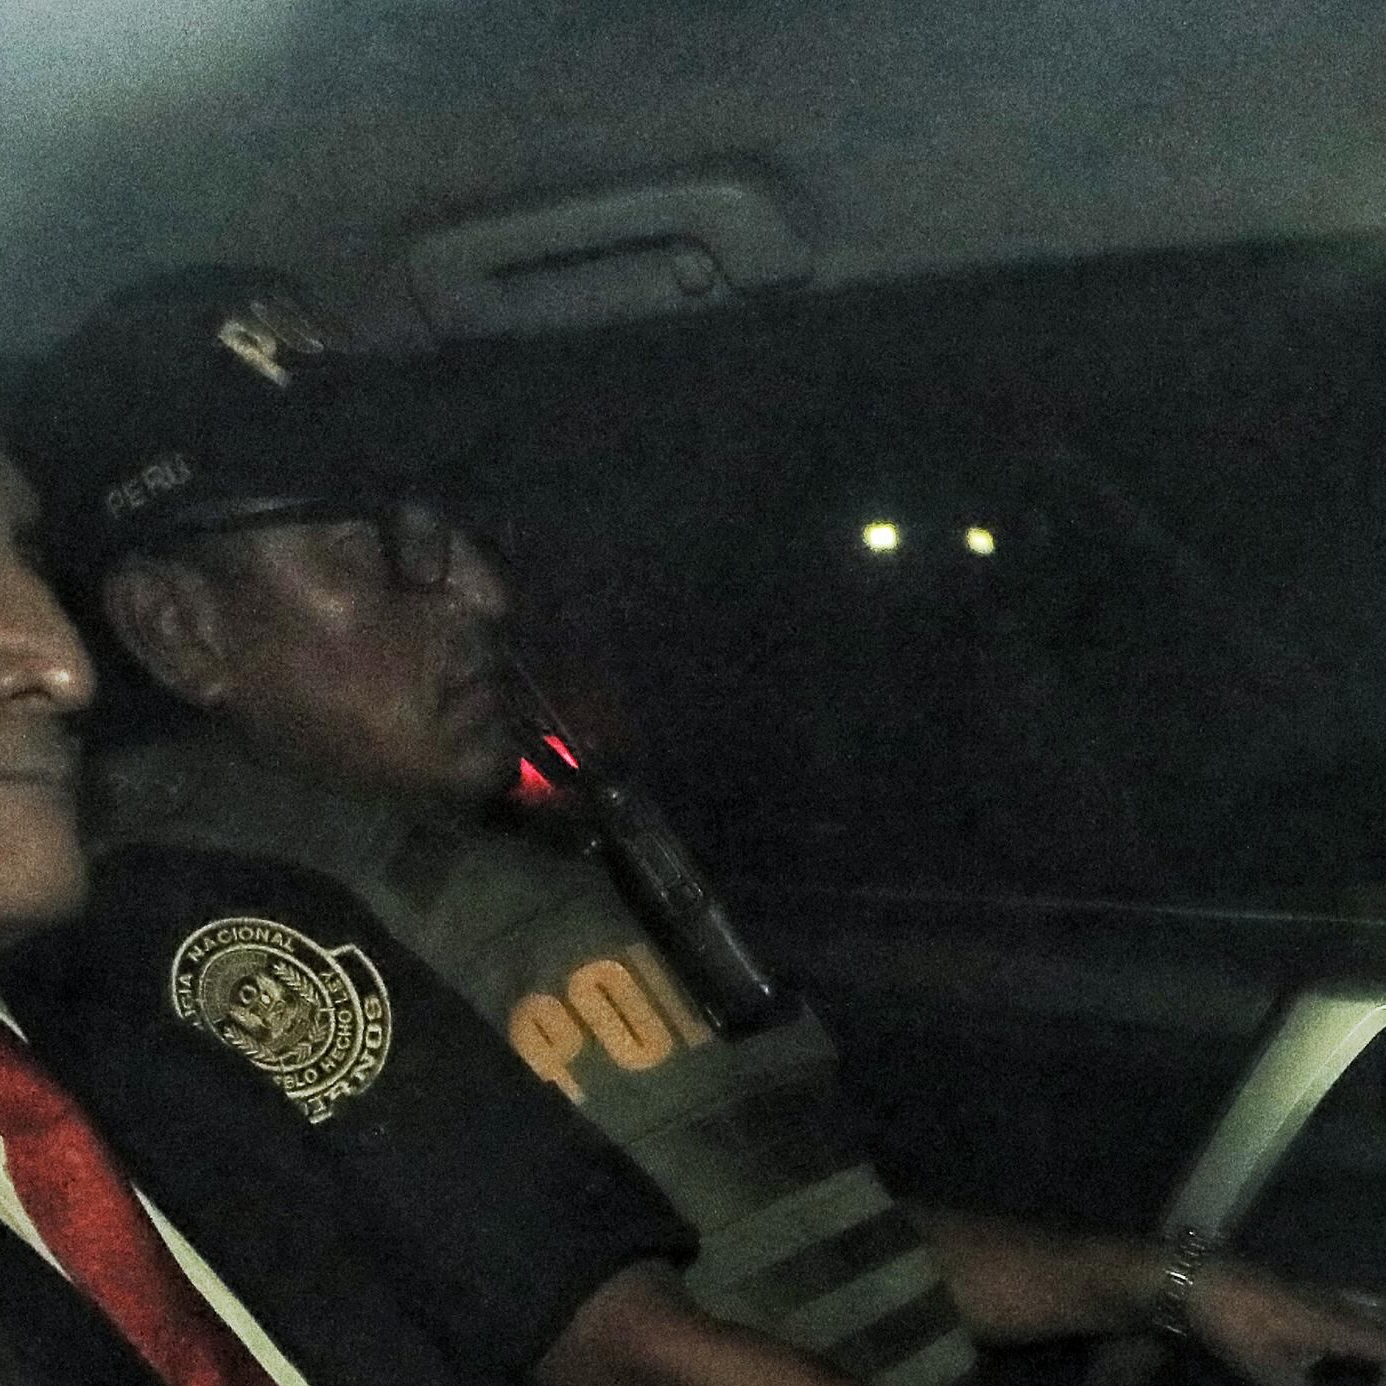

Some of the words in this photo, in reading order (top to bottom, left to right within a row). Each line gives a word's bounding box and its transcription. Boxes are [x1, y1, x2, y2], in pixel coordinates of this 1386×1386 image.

[188, 927, 294, 962] NACIONAL
[321, 971, 350, 1006] LEY
[322, 1009, 354, 1072] HECHO
